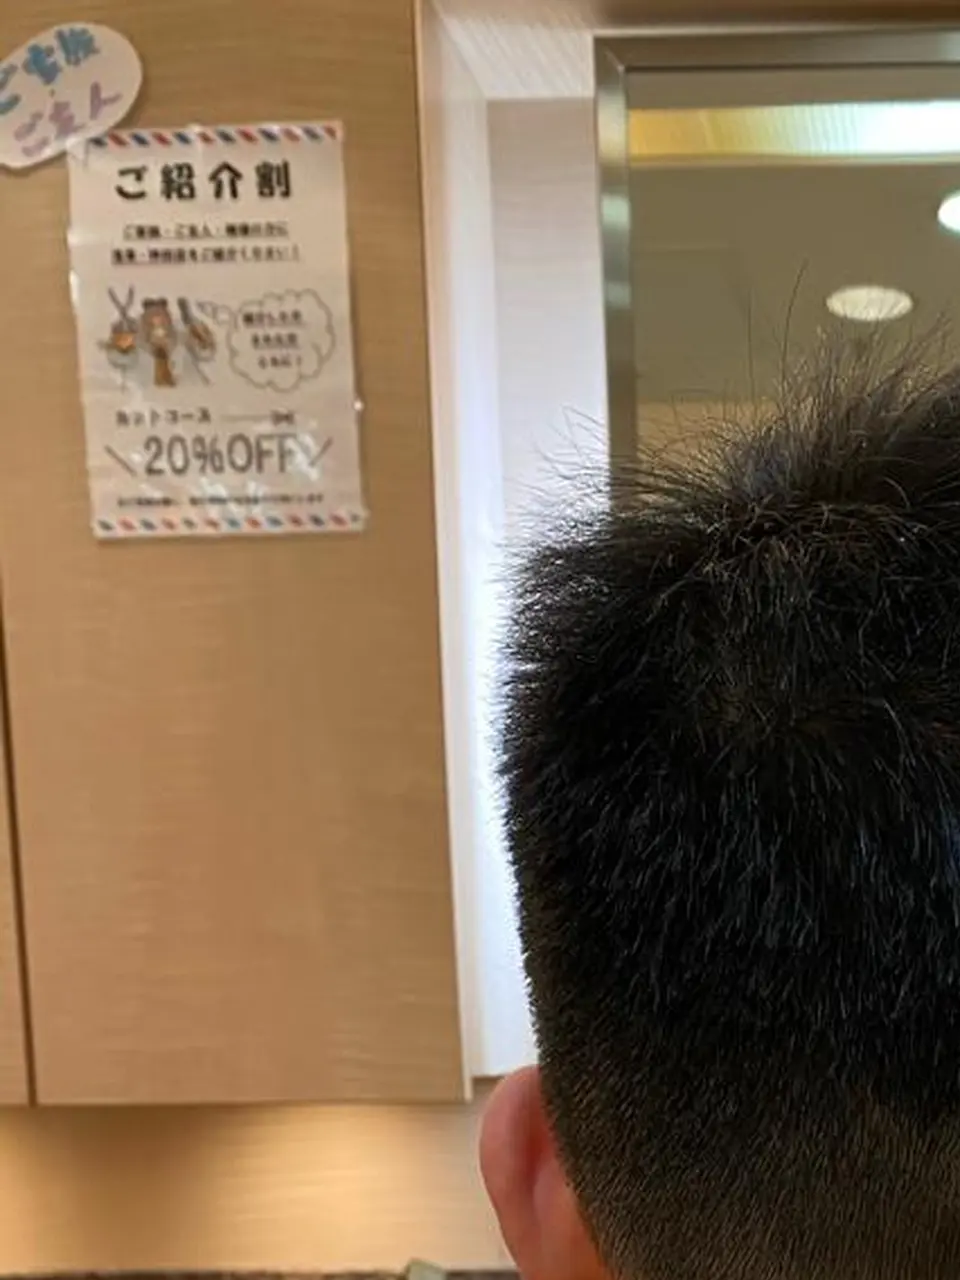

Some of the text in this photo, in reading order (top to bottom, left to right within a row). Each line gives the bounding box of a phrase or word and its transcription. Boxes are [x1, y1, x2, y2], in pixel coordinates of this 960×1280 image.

[115, 160, 291, 201] ご紹介割
[143, 432, 297, 477] 20%OFF
